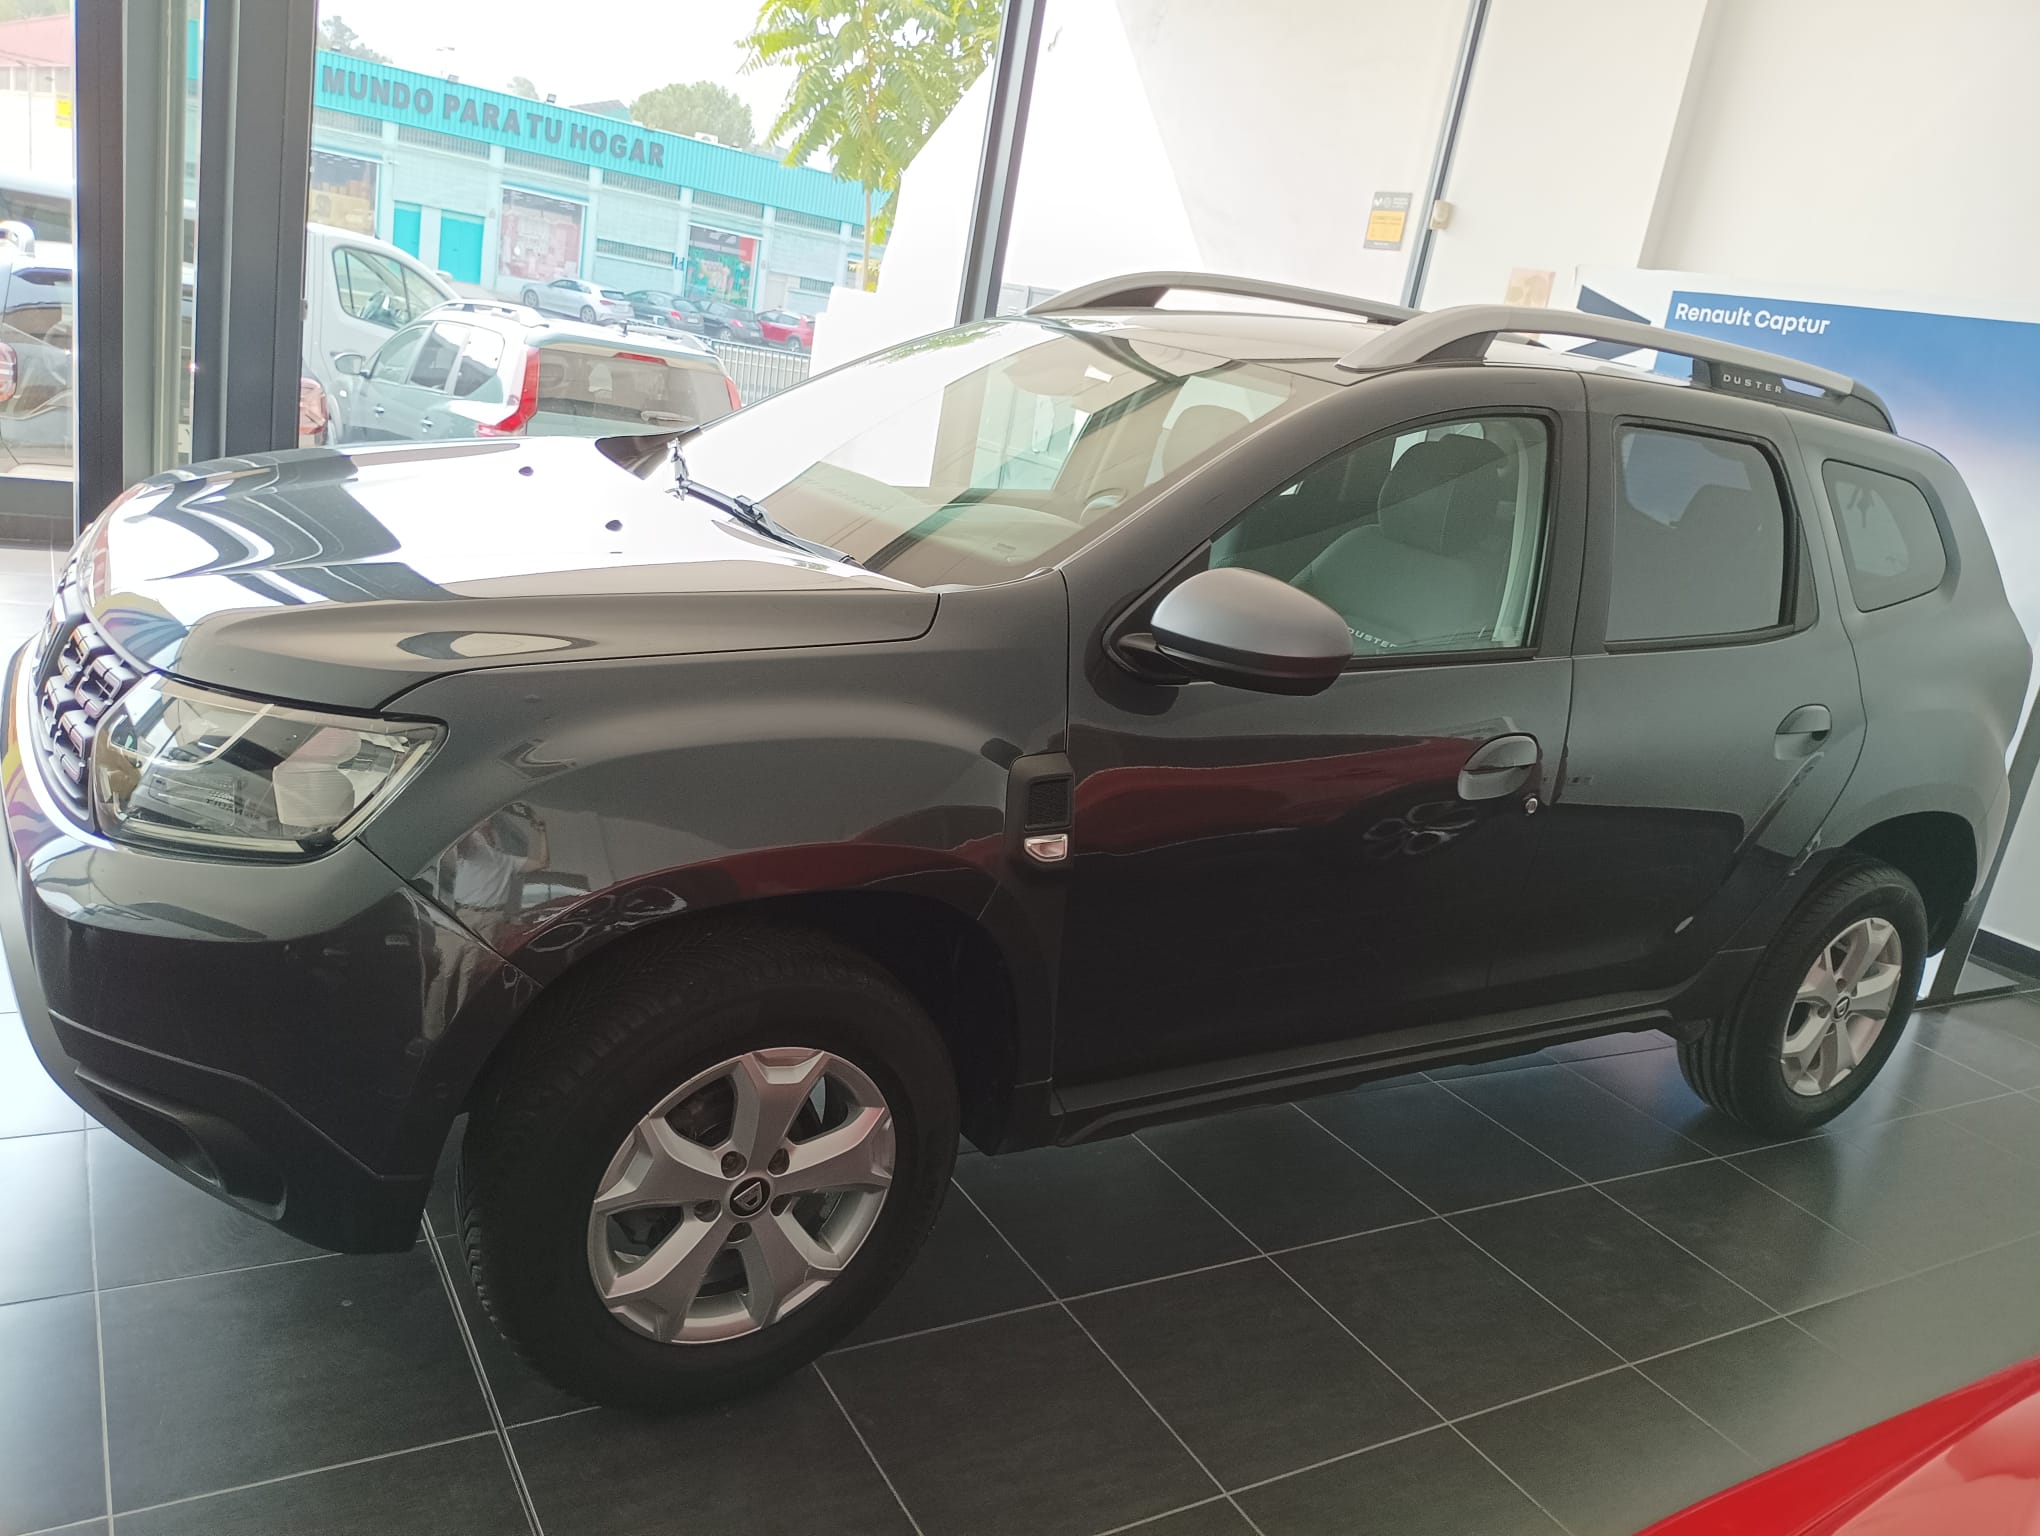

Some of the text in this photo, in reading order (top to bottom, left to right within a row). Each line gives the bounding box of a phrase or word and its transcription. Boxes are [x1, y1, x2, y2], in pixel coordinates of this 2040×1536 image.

[322, 65, 665, 168] MUNDO PARA TU HOGAR
[1674, 302, 1831, 336] Renault Captur
[1722, 373, 1783, 394] DUSTER
